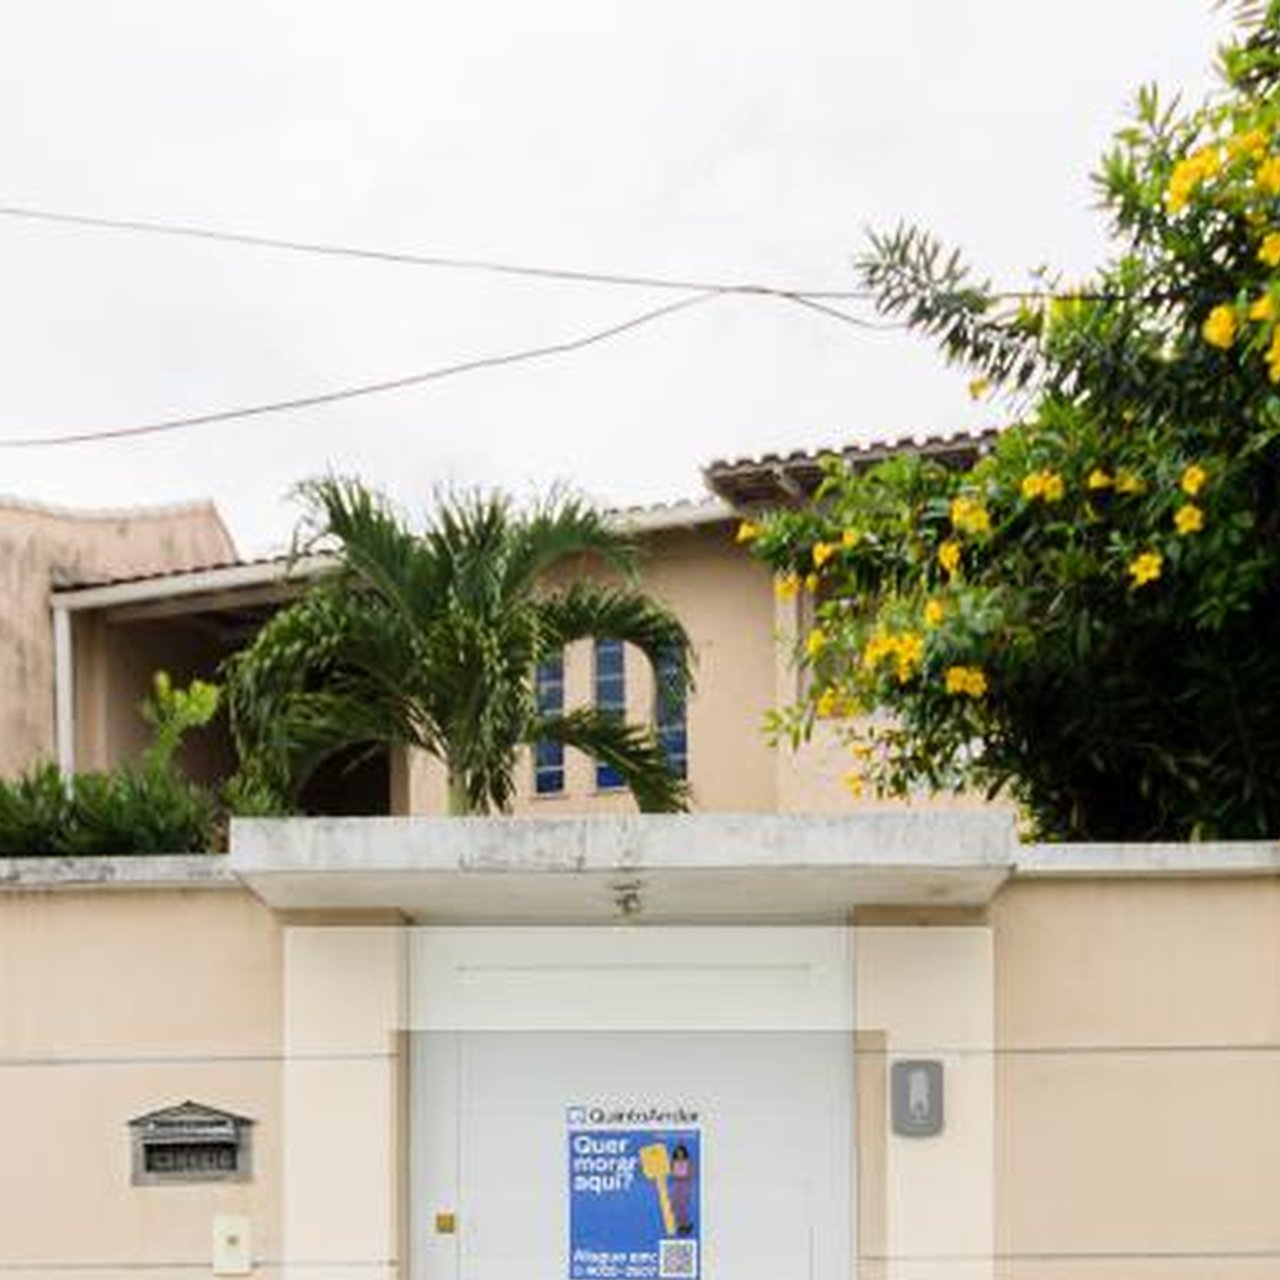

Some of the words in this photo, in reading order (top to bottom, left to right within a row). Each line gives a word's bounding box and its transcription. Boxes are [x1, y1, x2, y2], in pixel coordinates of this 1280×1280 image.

[574, 1136, 629, 1154] Quer
[574, 1157, 637, 1172] morar
[574, 1173, 634, 1194] aqui?
